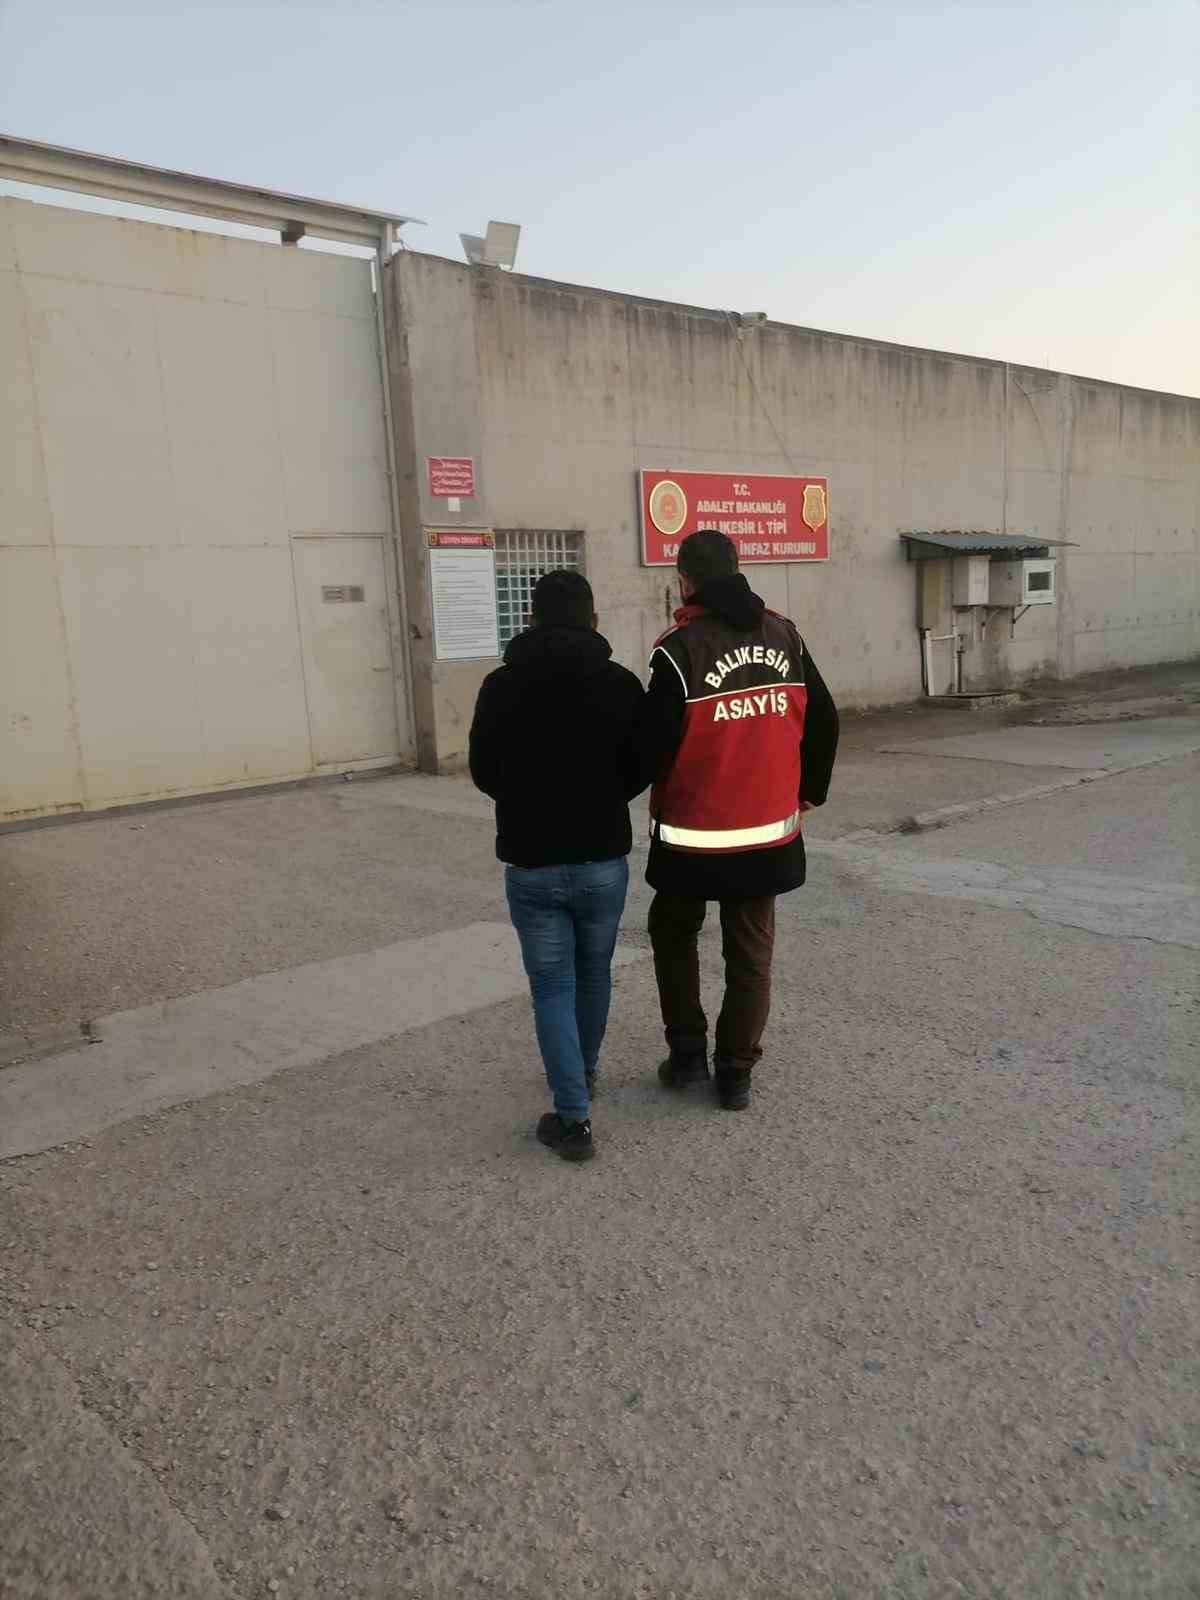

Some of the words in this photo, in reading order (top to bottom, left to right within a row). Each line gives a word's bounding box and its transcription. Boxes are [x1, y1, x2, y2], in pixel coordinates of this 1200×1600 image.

[733, 483, 751, 496] T.C.
[696, 500, 735, 513] ADALET
[736, 500, 786, 514] BAKANLIĞI
[766, 519, 787, 535] TİPİ
[739, 540, 770, 556] İNFAZ
[772, 542, 816, 556] KURUMU
[704, 645, 791, 689] BALIKESİR
[713, 689, 788, 722] ASAYİŞ
